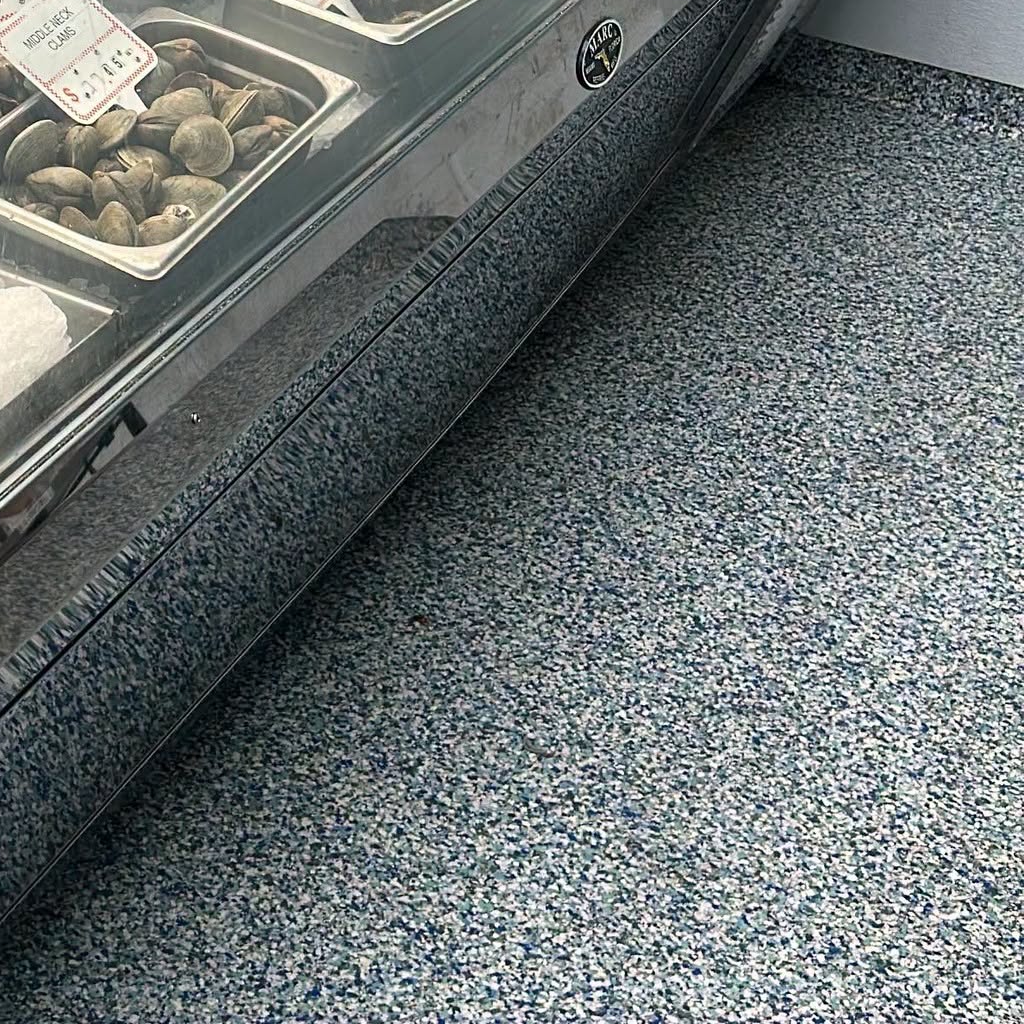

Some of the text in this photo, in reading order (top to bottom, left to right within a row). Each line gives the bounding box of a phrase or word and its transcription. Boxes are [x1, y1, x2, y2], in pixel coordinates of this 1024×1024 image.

[22, 6, 75, 51] MIDDLE NECK
[47, 26, 77, 52] CLAMS
